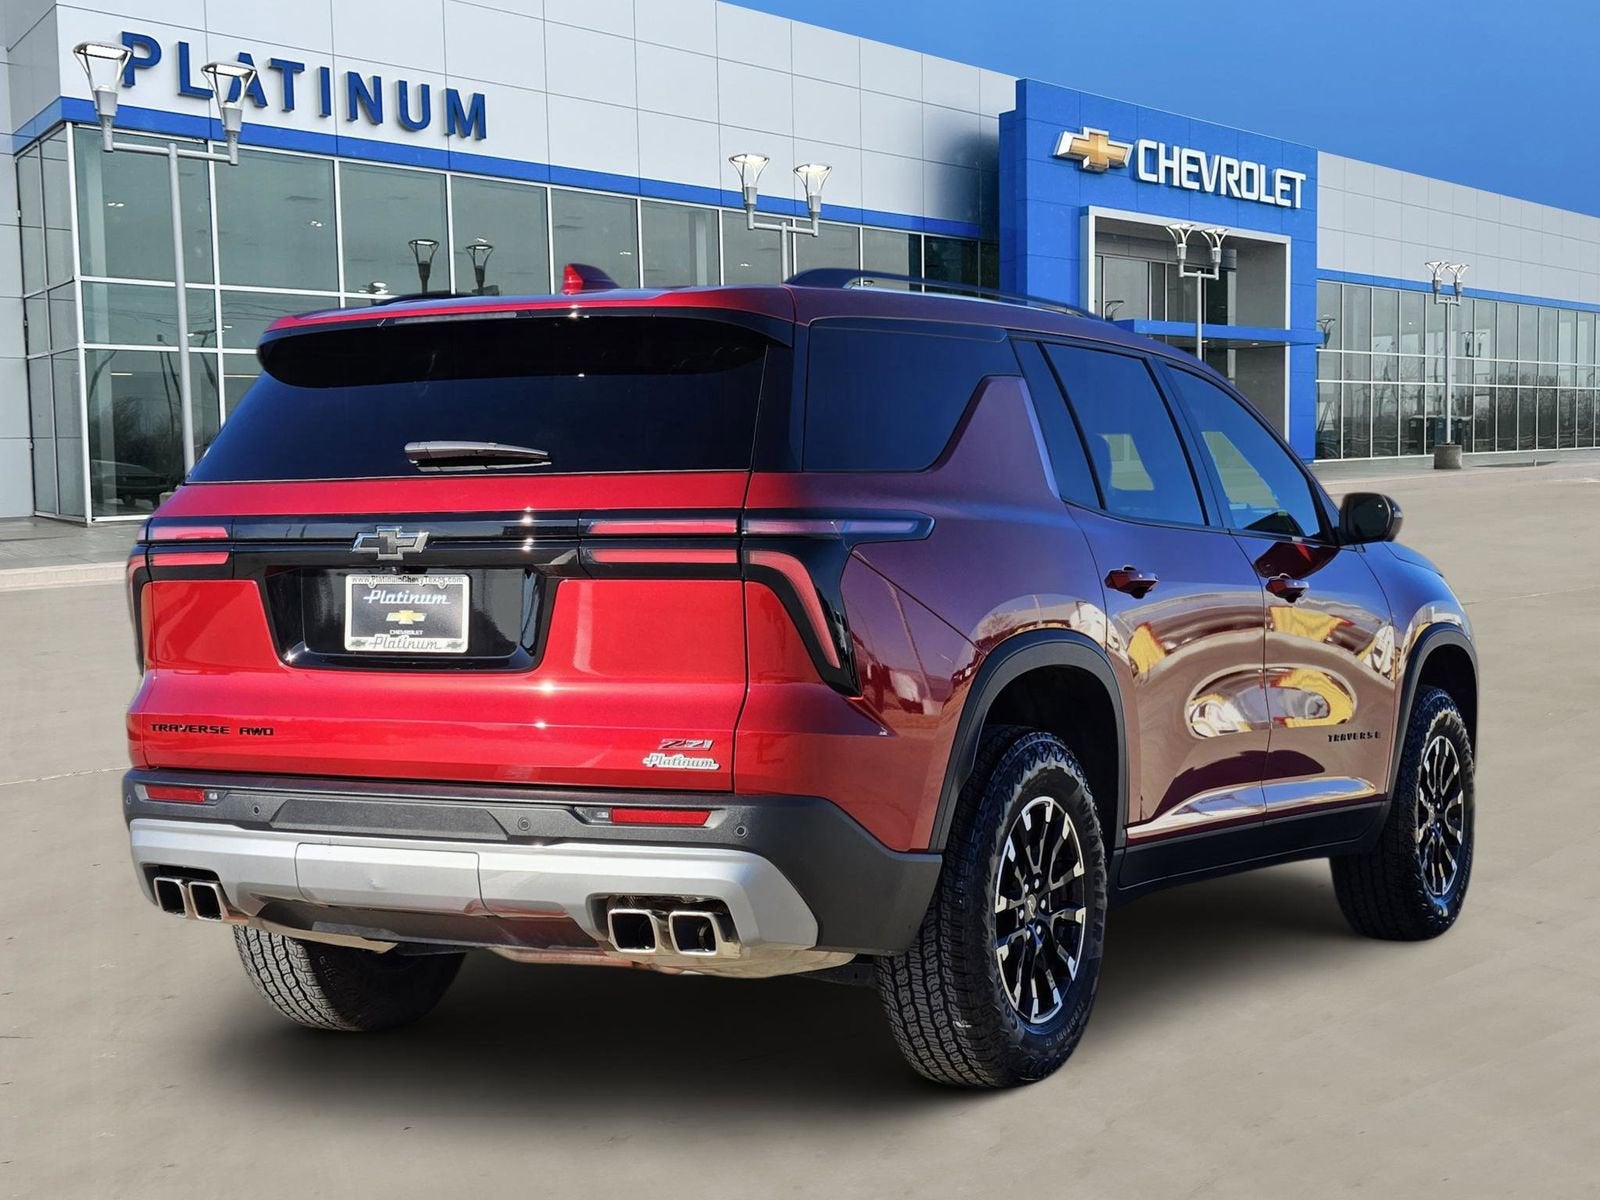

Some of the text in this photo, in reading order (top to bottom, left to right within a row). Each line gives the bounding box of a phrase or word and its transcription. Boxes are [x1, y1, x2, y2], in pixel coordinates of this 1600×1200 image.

[121, 31, 487, 140] PLATINUM
[1136, 138, 1306, 208] CHEVROLET
[362, 589, 452, 605] Platinum
[369, 636, 442, 650] Platinum
[151, 723, 274, 736] TRAVERSE AWD
[1327, 731, 1381, 743] TRAVERSE
[658, 739, 714, 751] Z71
[642, 752, 721, 770] Platinum
[1078, 795, 1105, 943] WRANGLER
